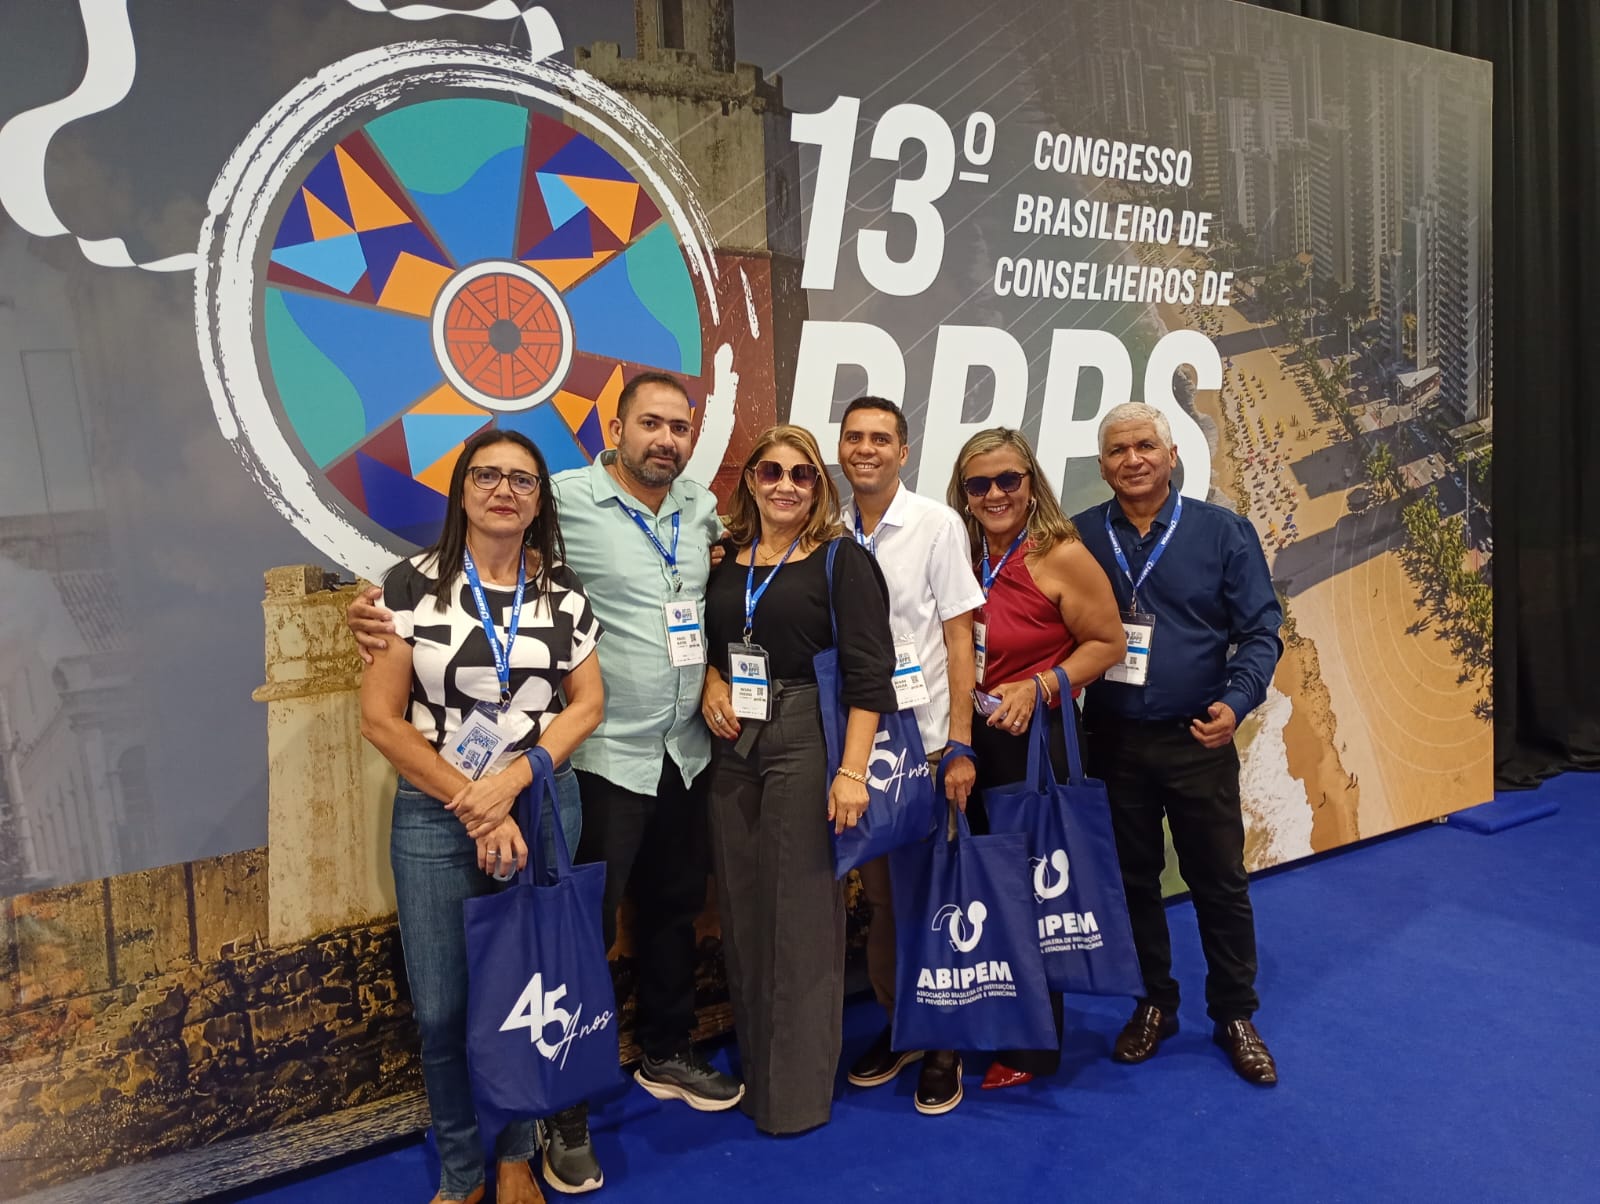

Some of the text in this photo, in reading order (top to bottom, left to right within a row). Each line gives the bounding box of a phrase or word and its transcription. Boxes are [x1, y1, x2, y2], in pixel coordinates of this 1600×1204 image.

[1034, 130, 1193, 187] CONGRESSO
[791, 95, 996, 297] 13º
[1013, 193, 1213, 248] BRASILEIRO DE
[993, 256, 1235, 307] CONSELHEIROS DE
[866, 729, 899, 792] 5
[916, 960, 1014, 990] ABIPEM
[498, 972, 613, 1071] 45 Anos
